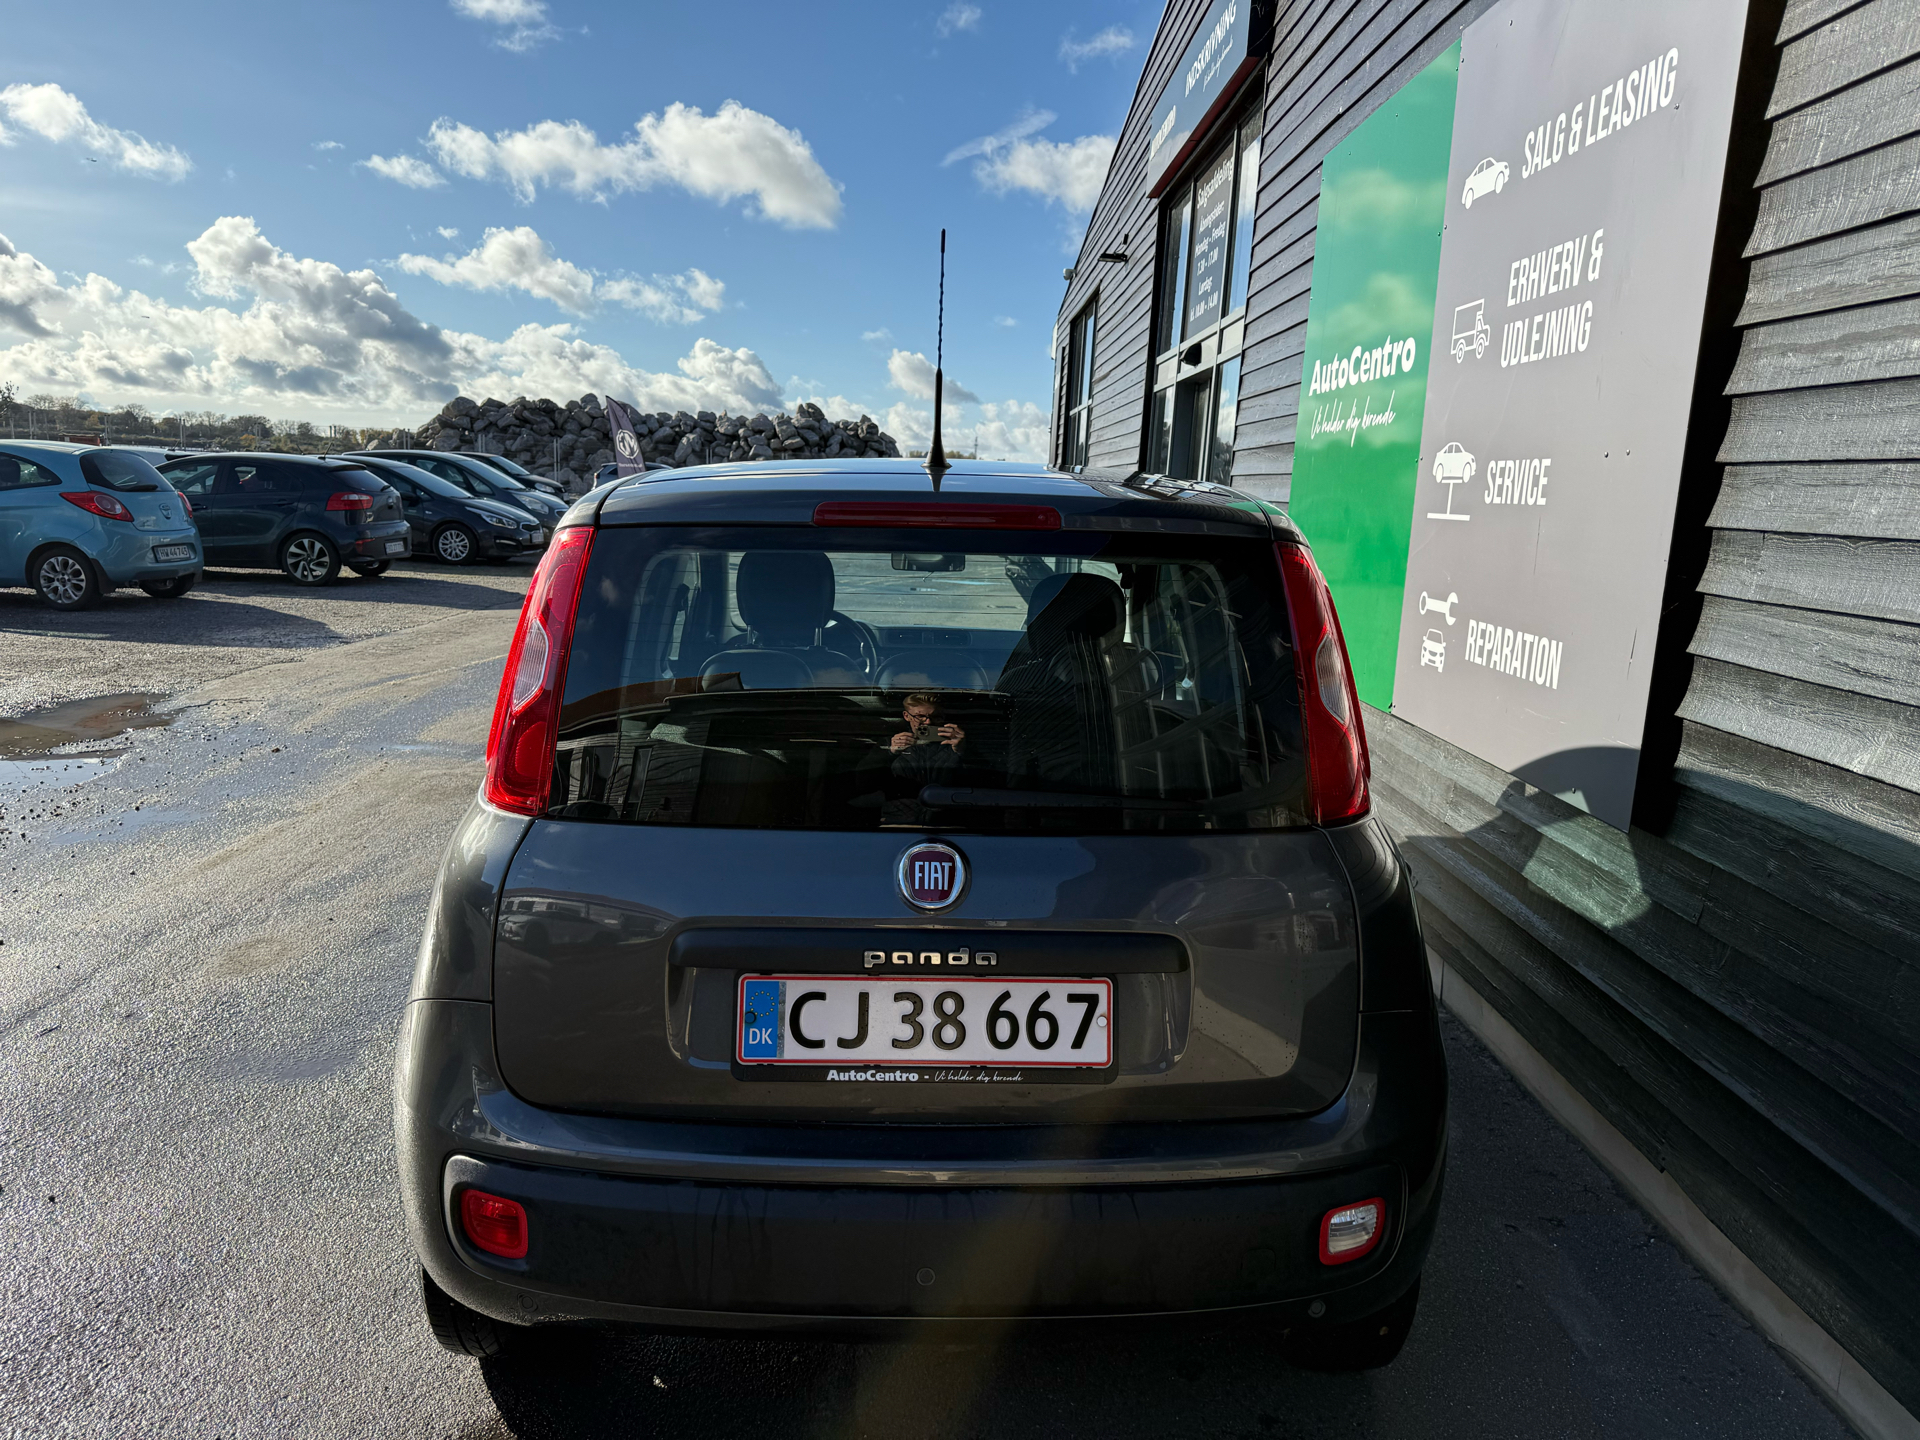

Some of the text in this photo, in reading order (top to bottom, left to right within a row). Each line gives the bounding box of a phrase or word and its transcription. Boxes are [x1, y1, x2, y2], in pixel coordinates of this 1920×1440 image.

[1521, 47, 1679, 180] SALG & LEASING
[1507, 228, 1604, 307] ERHVERV &
[1500, 300, 1593, 368] UDLEJNING
[1308, 335, 1416, 397] AutoCentro
[1484, 458, 1552, 506] SERVICE
[1464, 619, 1563, 690] REPARATION
[914, 861, 953, 891] FIAT
[863, 947, 998, 968] panda
[749, 1028, 773, 1045] DK
[788, 990, 1100, 1051] CJ 38 667
[826, 1069, 919, 1082] AutoCentro
